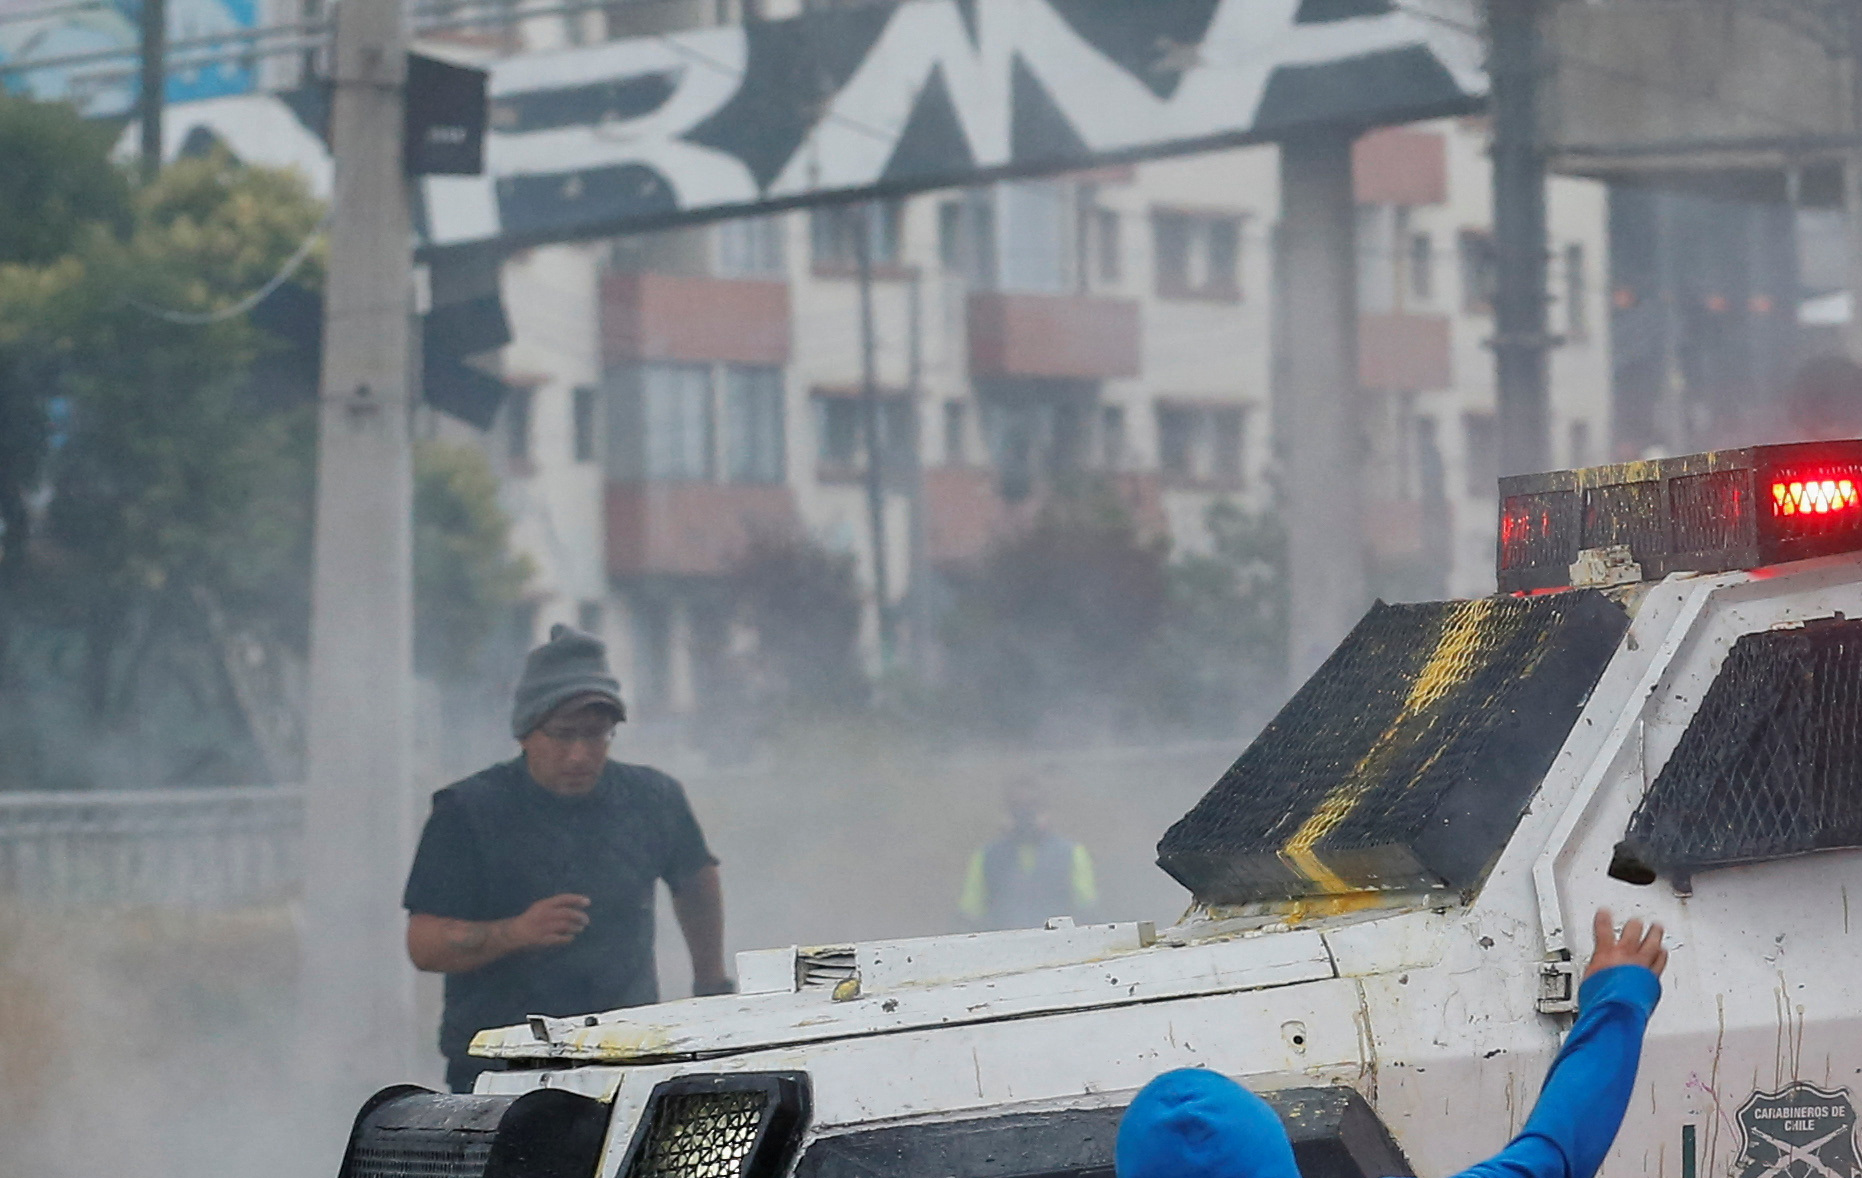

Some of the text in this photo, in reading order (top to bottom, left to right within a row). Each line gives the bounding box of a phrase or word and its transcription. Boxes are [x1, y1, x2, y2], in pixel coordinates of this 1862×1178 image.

[1754, 1105, 1846, 1119] CARABINEROS DE
[1784, 1120, 1815, 1131] CHILE
